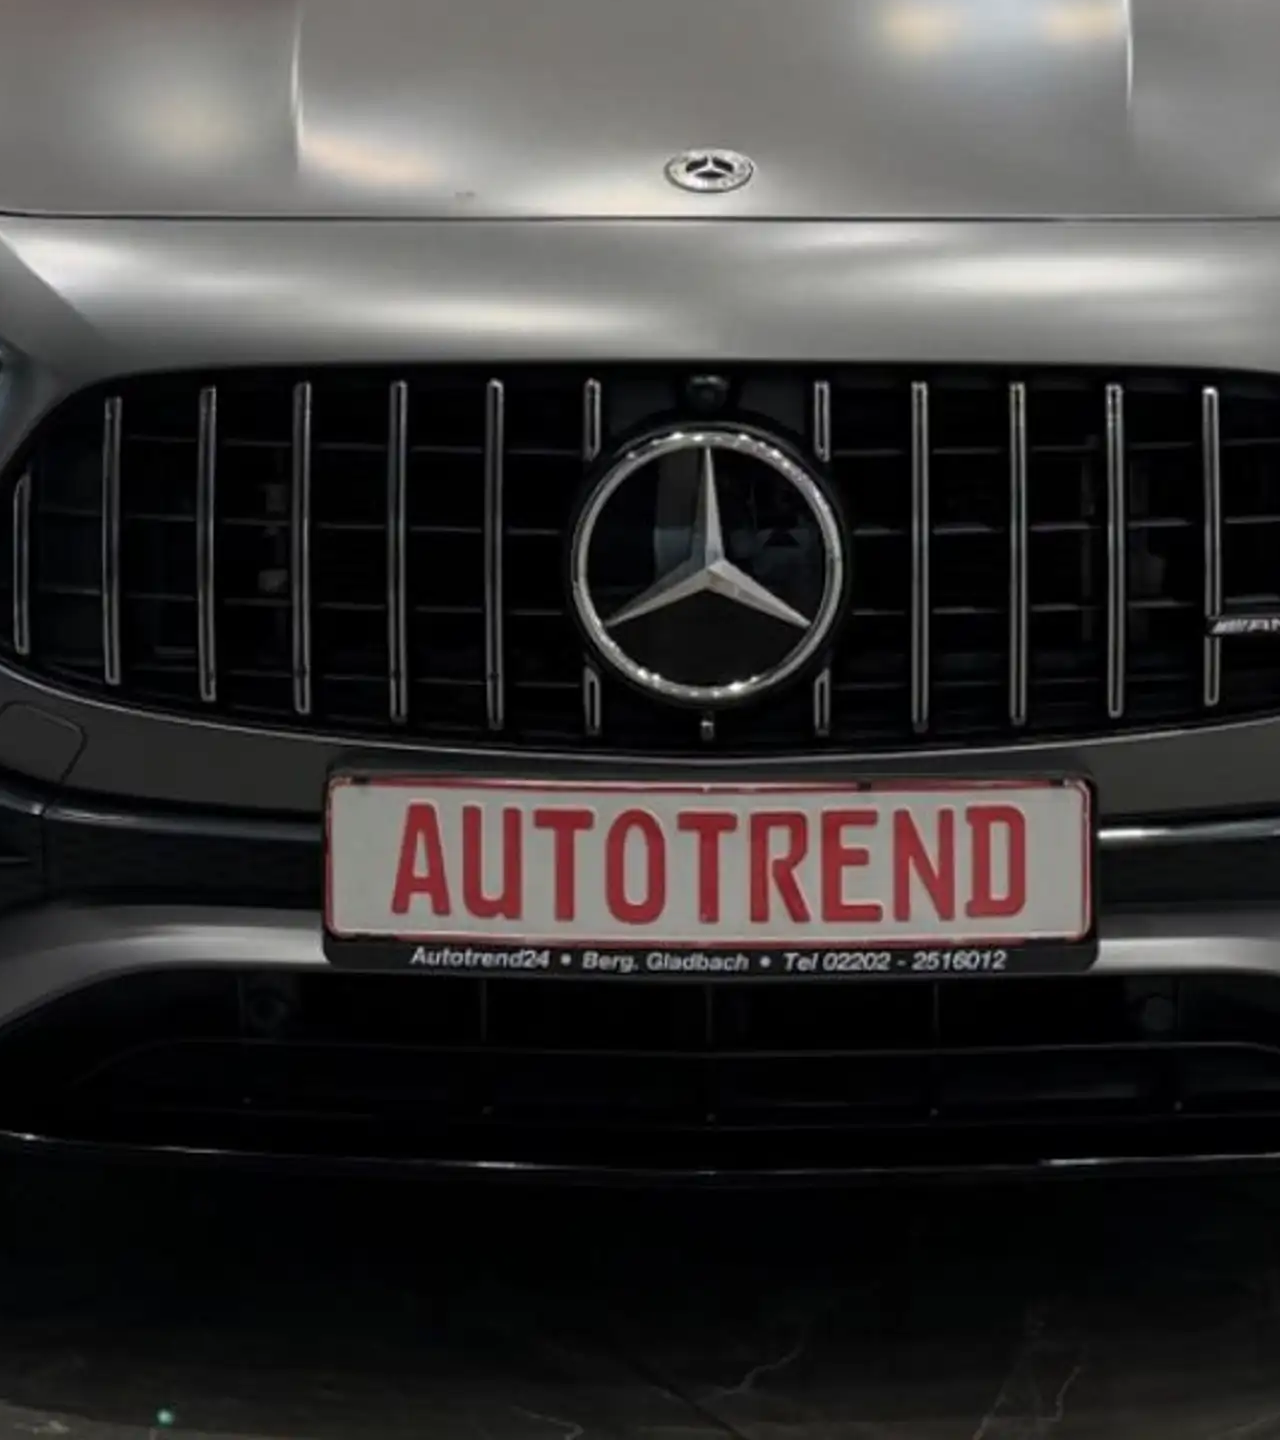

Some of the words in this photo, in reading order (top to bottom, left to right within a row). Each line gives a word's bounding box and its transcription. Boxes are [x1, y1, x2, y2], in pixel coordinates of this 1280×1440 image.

[392, 803, 1026, 924] AUTOTREND
[411, 947, 550, 969] Autotrend24
[582, 951, 638, 972] Berg.
[646, 951, 749, 971] Gladbach
[785, 952, 818, 971] Tel
[823, 951, 891, 971] 02202
[912, 950, 1008, 971] 2516012
